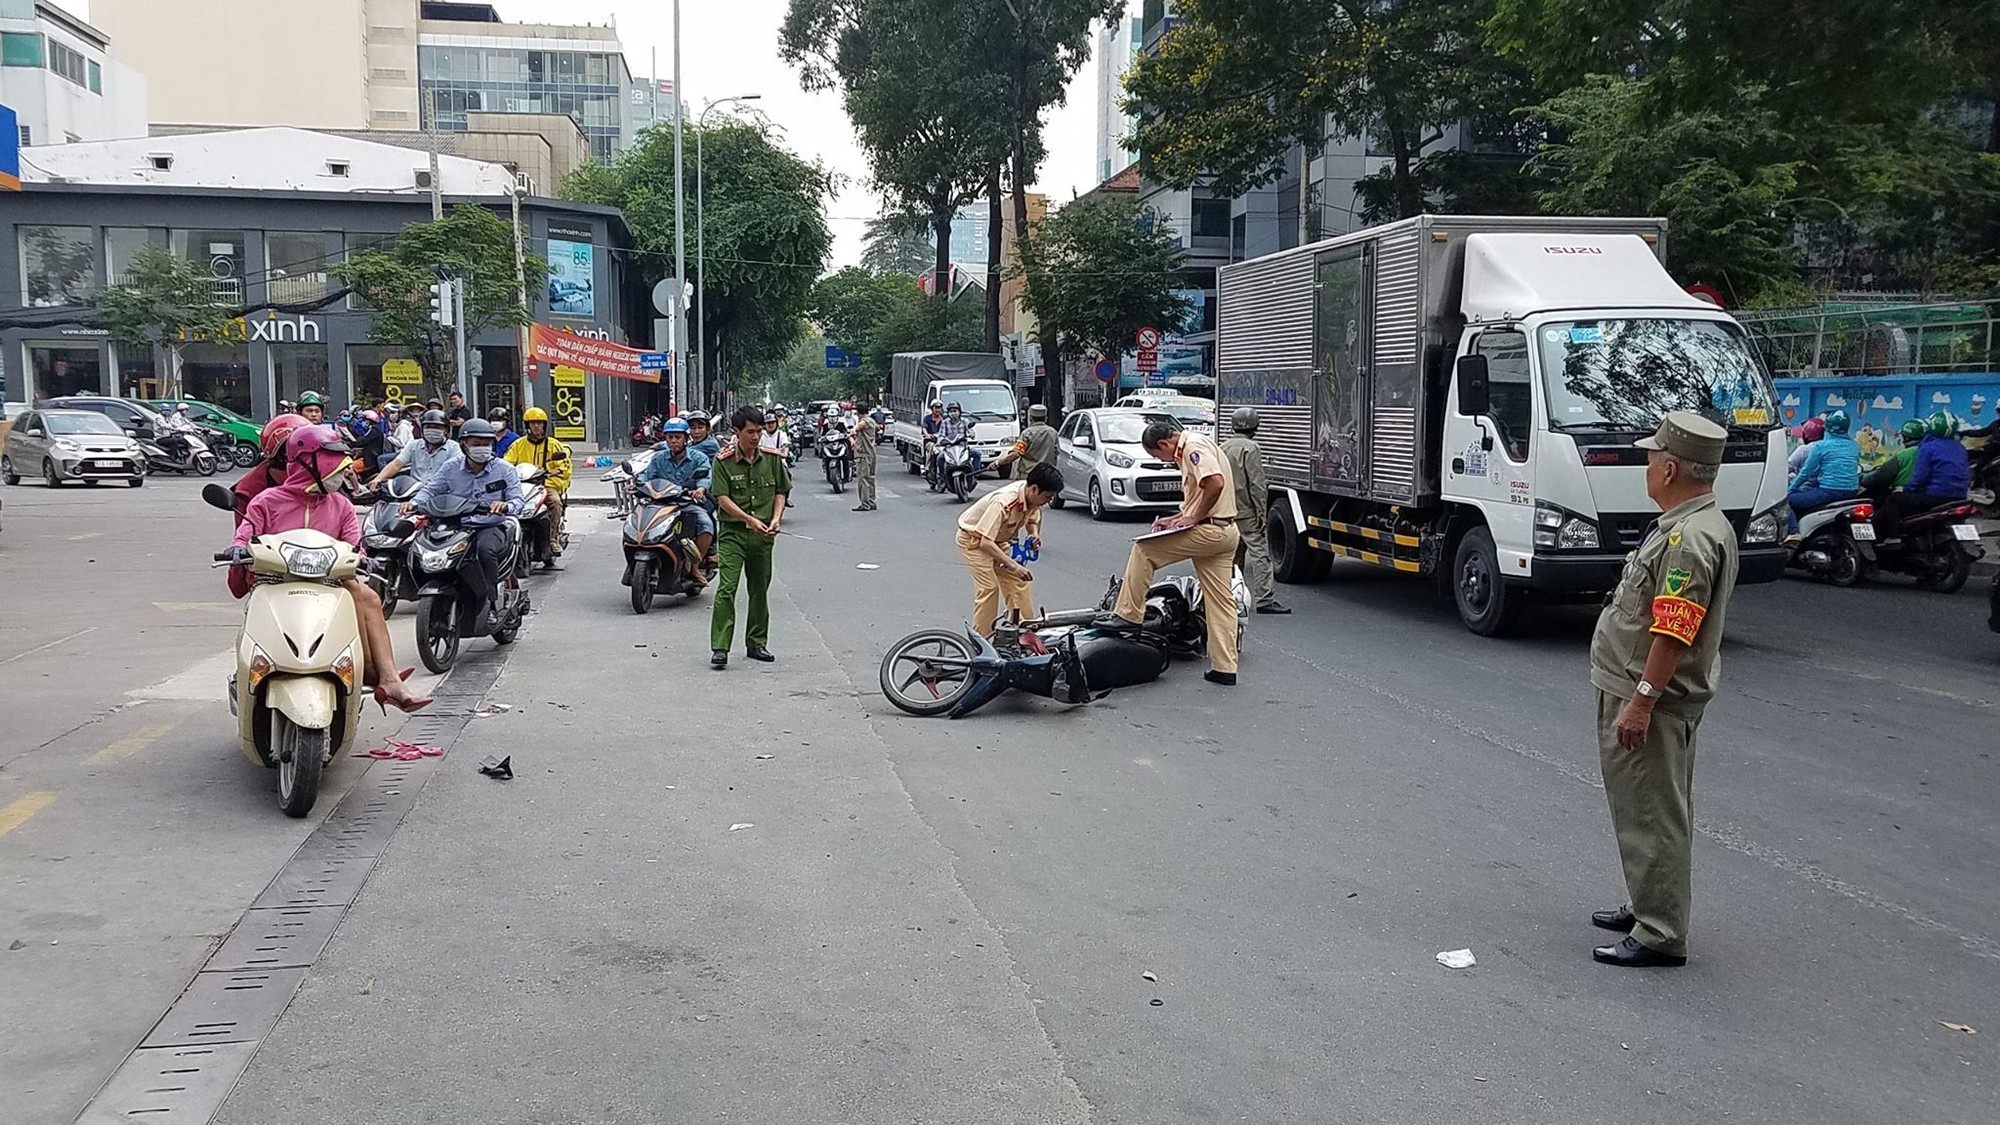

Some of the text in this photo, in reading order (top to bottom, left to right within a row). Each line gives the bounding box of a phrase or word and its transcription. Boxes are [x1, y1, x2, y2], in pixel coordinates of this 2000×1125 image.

[1544, 246, 1602, 254] ISUZU
[556, 387, 583, 425] 85
[1510, 481, 1530, 489] ISUZU
